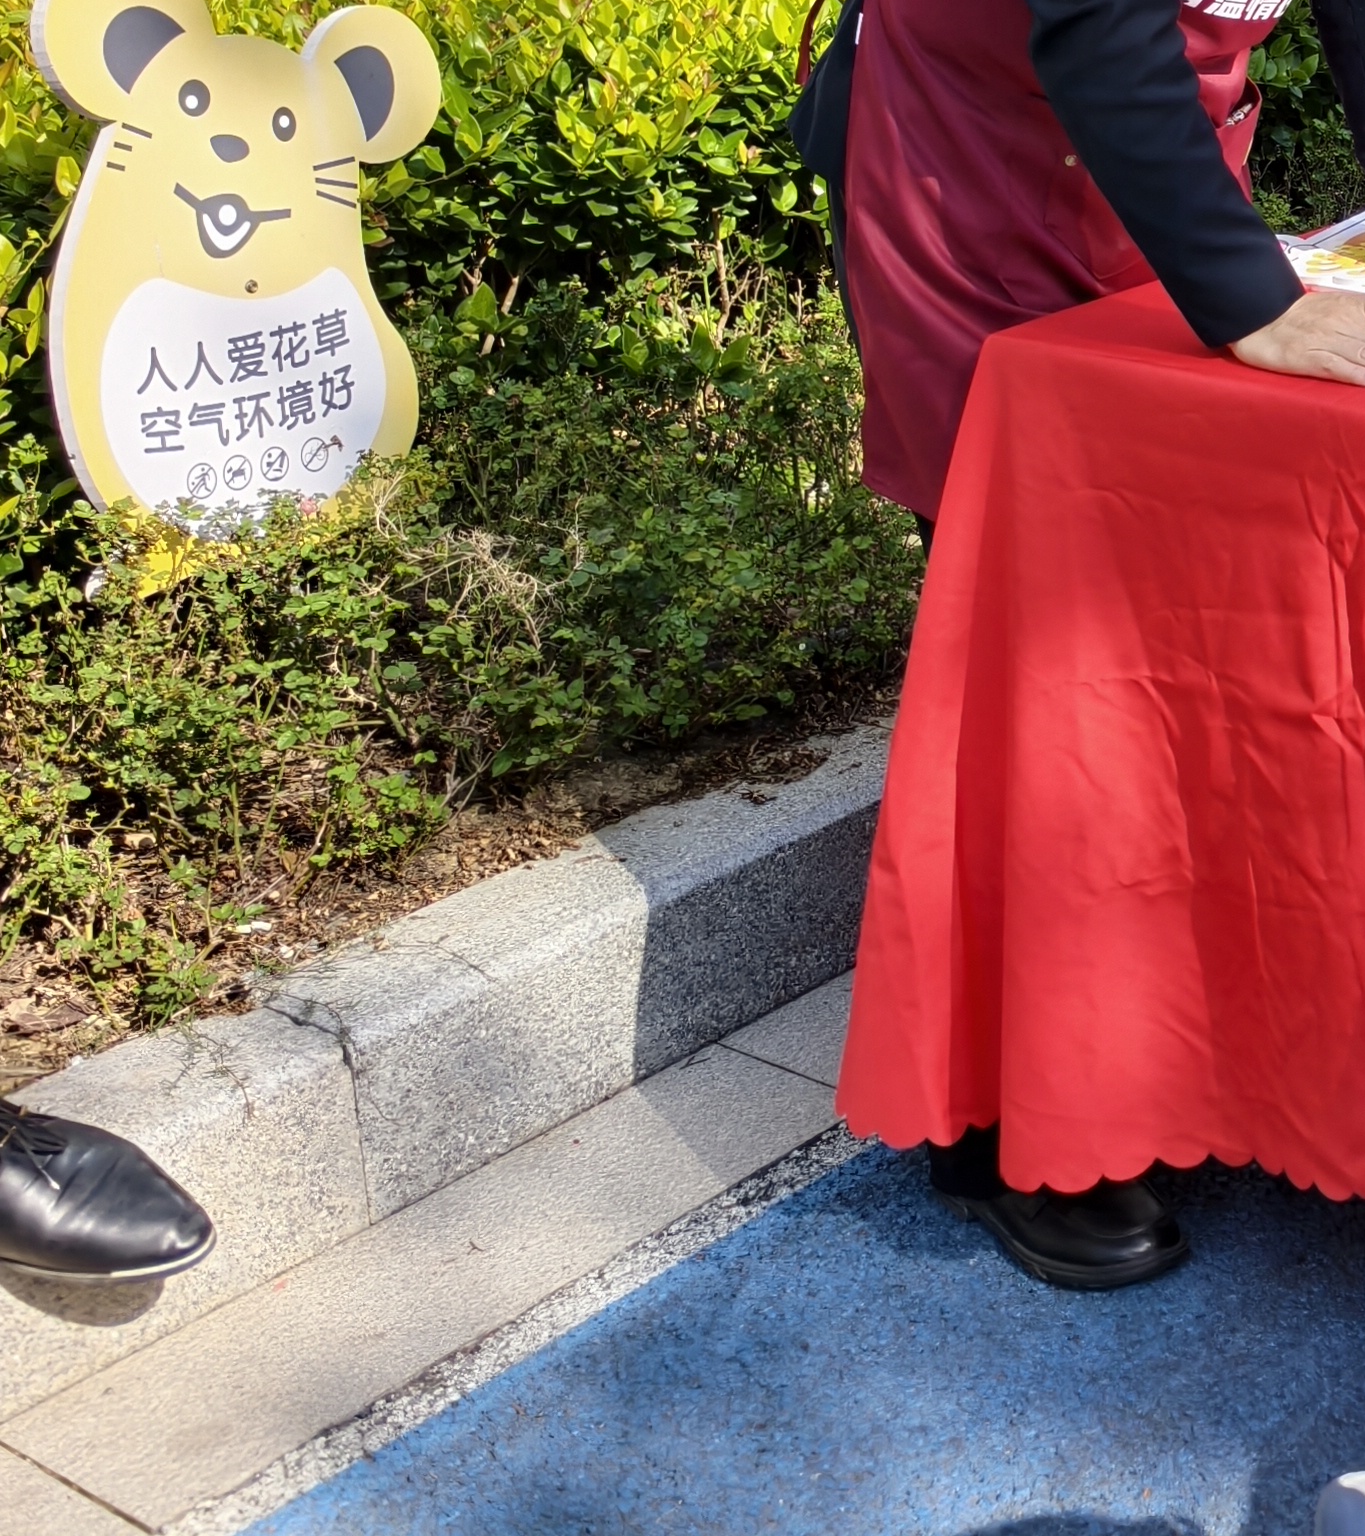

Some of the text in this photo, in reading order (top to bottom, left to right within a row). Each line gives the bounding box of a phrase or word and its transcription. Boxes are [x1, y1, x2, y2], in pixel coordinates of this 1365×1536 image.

[137, 308, 350, 395] 人人爱花草
[139, 364, 356, 454] 空气环境好
